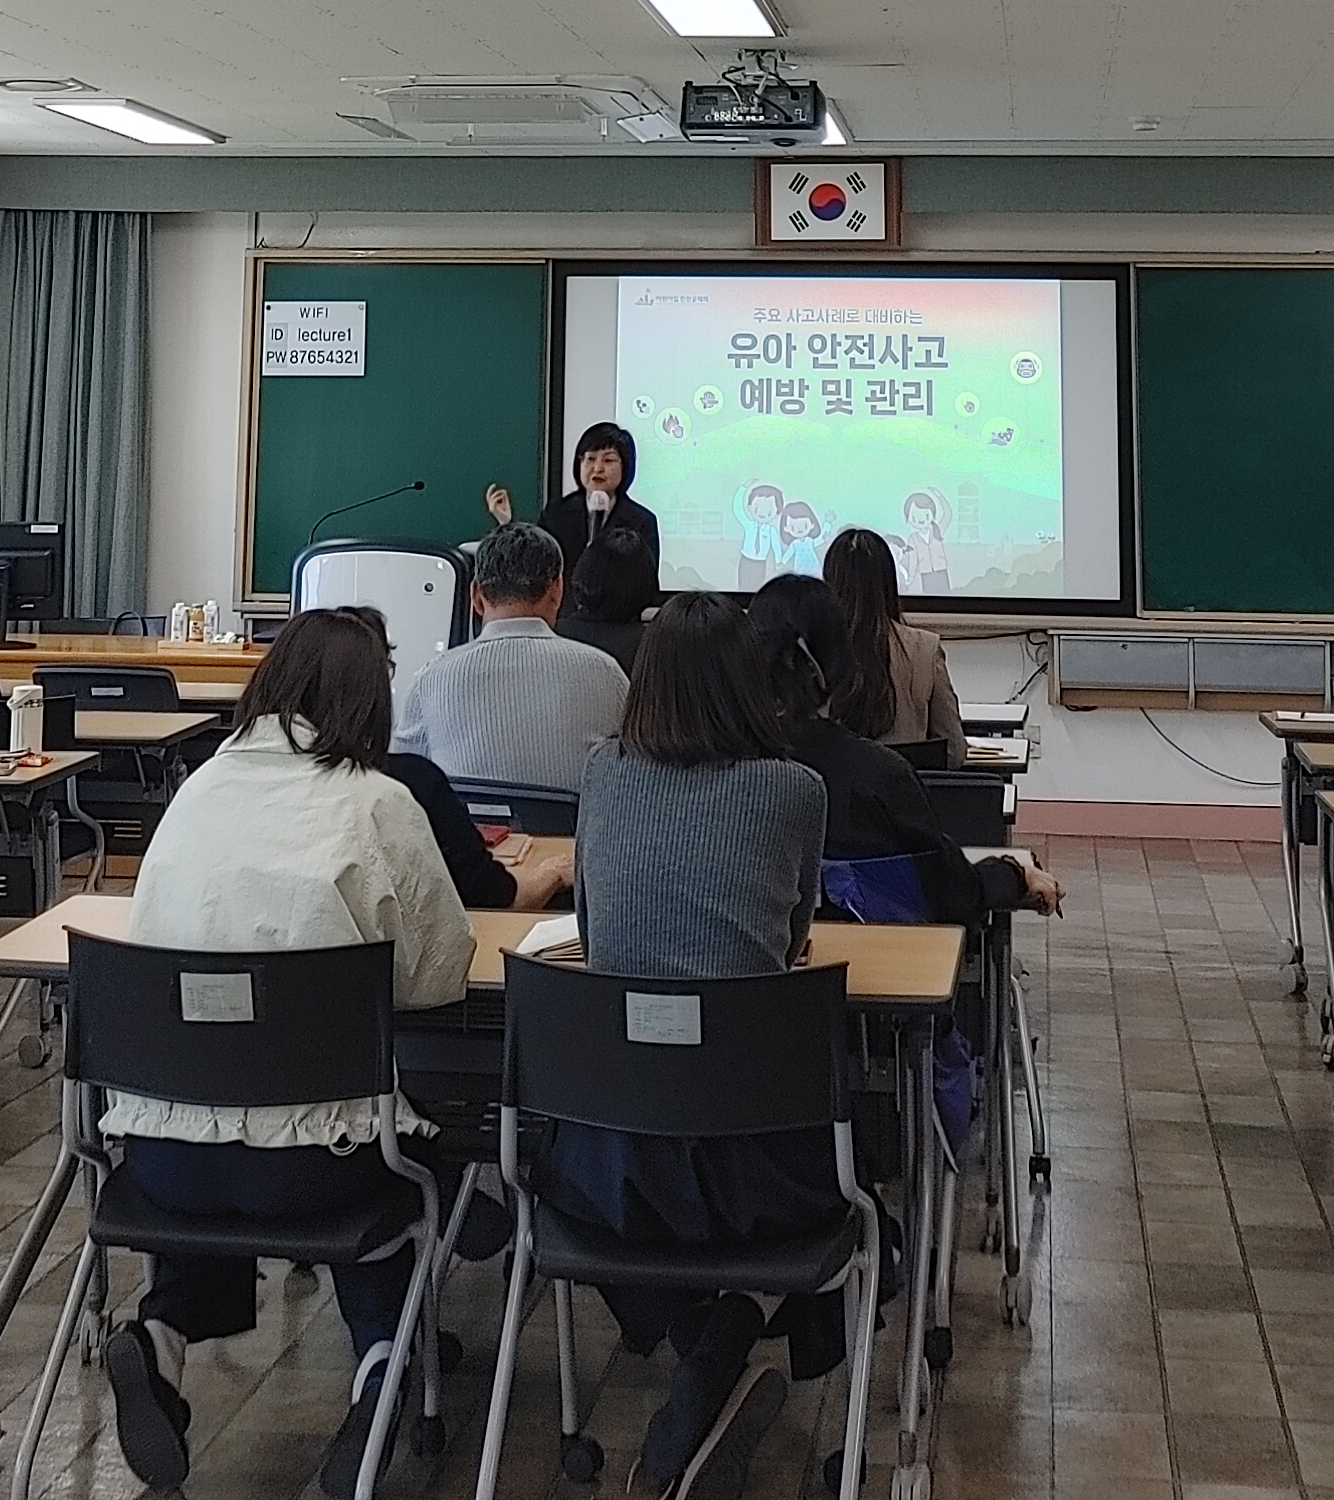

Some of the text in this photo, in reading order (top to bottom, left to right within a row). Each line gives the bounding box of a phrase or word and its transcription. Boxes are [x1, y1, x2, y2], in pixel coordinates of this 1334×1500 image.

[300, 307, 328, 318] WIFI
[753, 307, 923, 325] 주요 사고사례로 대비하는
[271, 327, 351, 342] ID lecture1
[266, 349, 359, 364] PW 87654321
[727, 332, 949, 370] 유아 안전사고
[740, 378, 934, 416] 예방 및 관리
